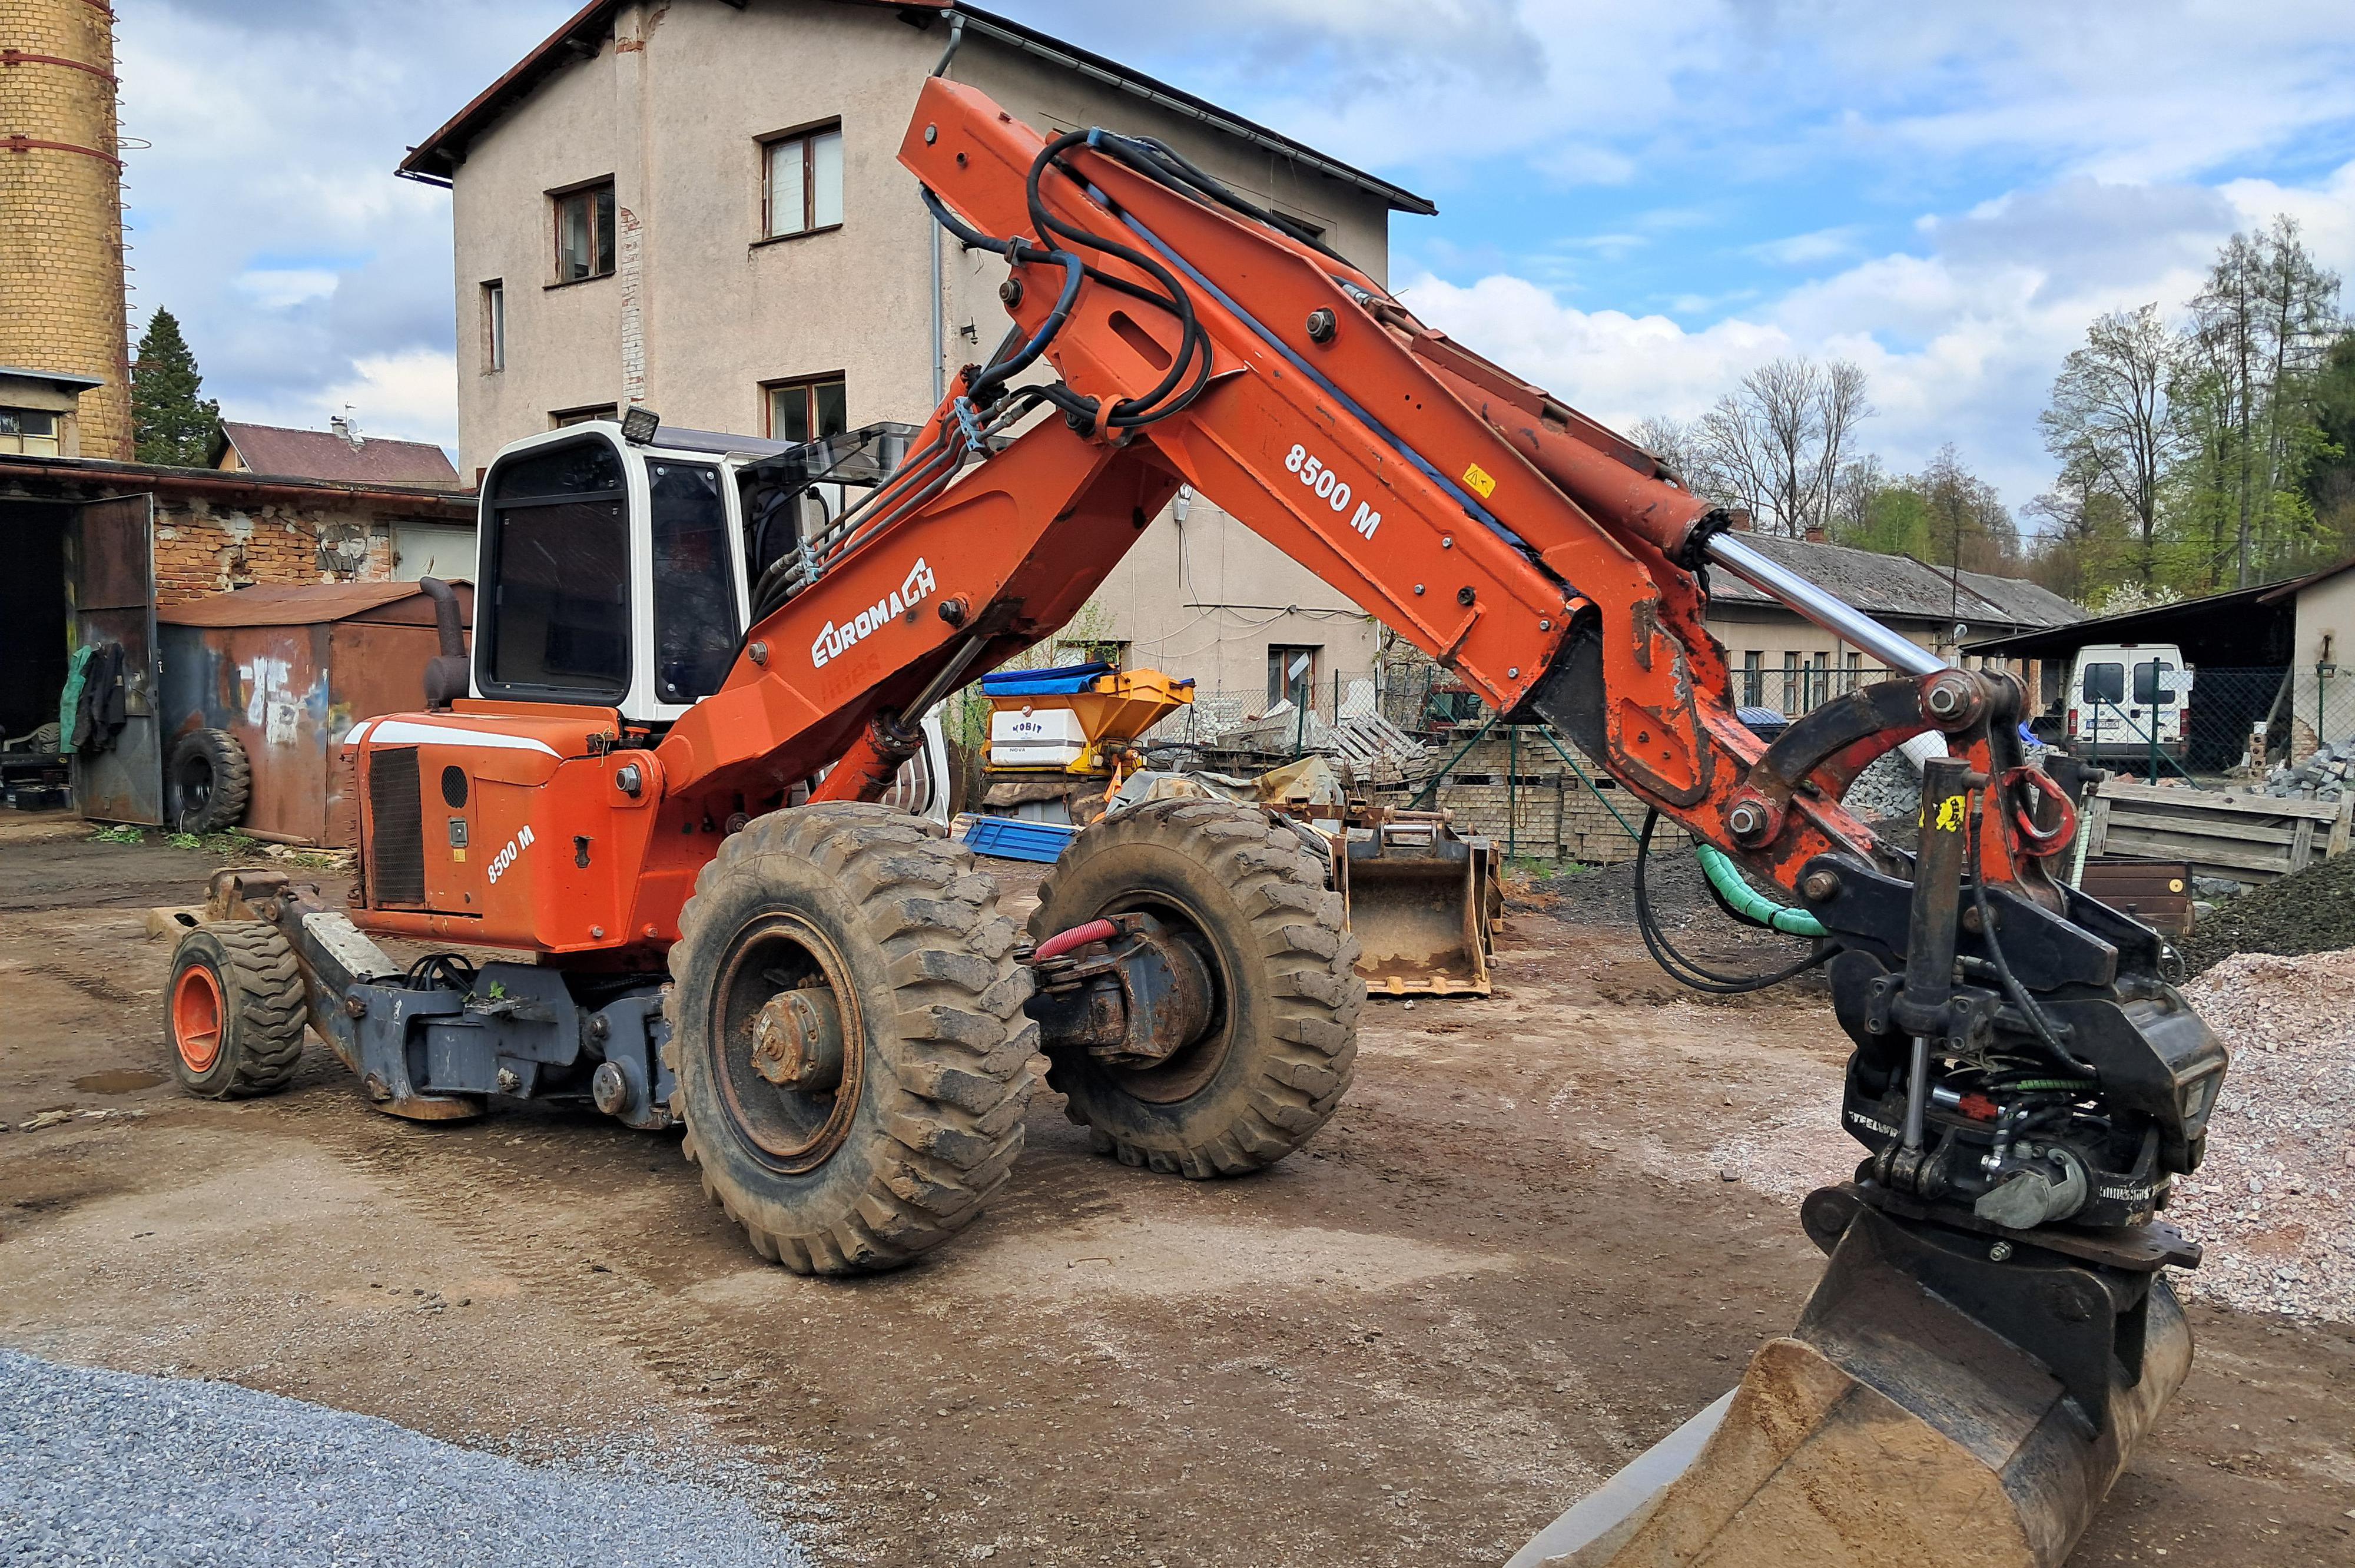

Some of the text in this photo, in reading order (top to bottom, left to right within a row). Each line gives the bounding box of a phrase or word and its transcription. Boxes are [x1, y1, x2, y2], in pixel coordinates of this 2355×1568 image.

[1285, 443, 1381, 541] 8500 M
[811, 556, 937, 668] EUROMACH
[487, 824, 535, 884] 8500 M
